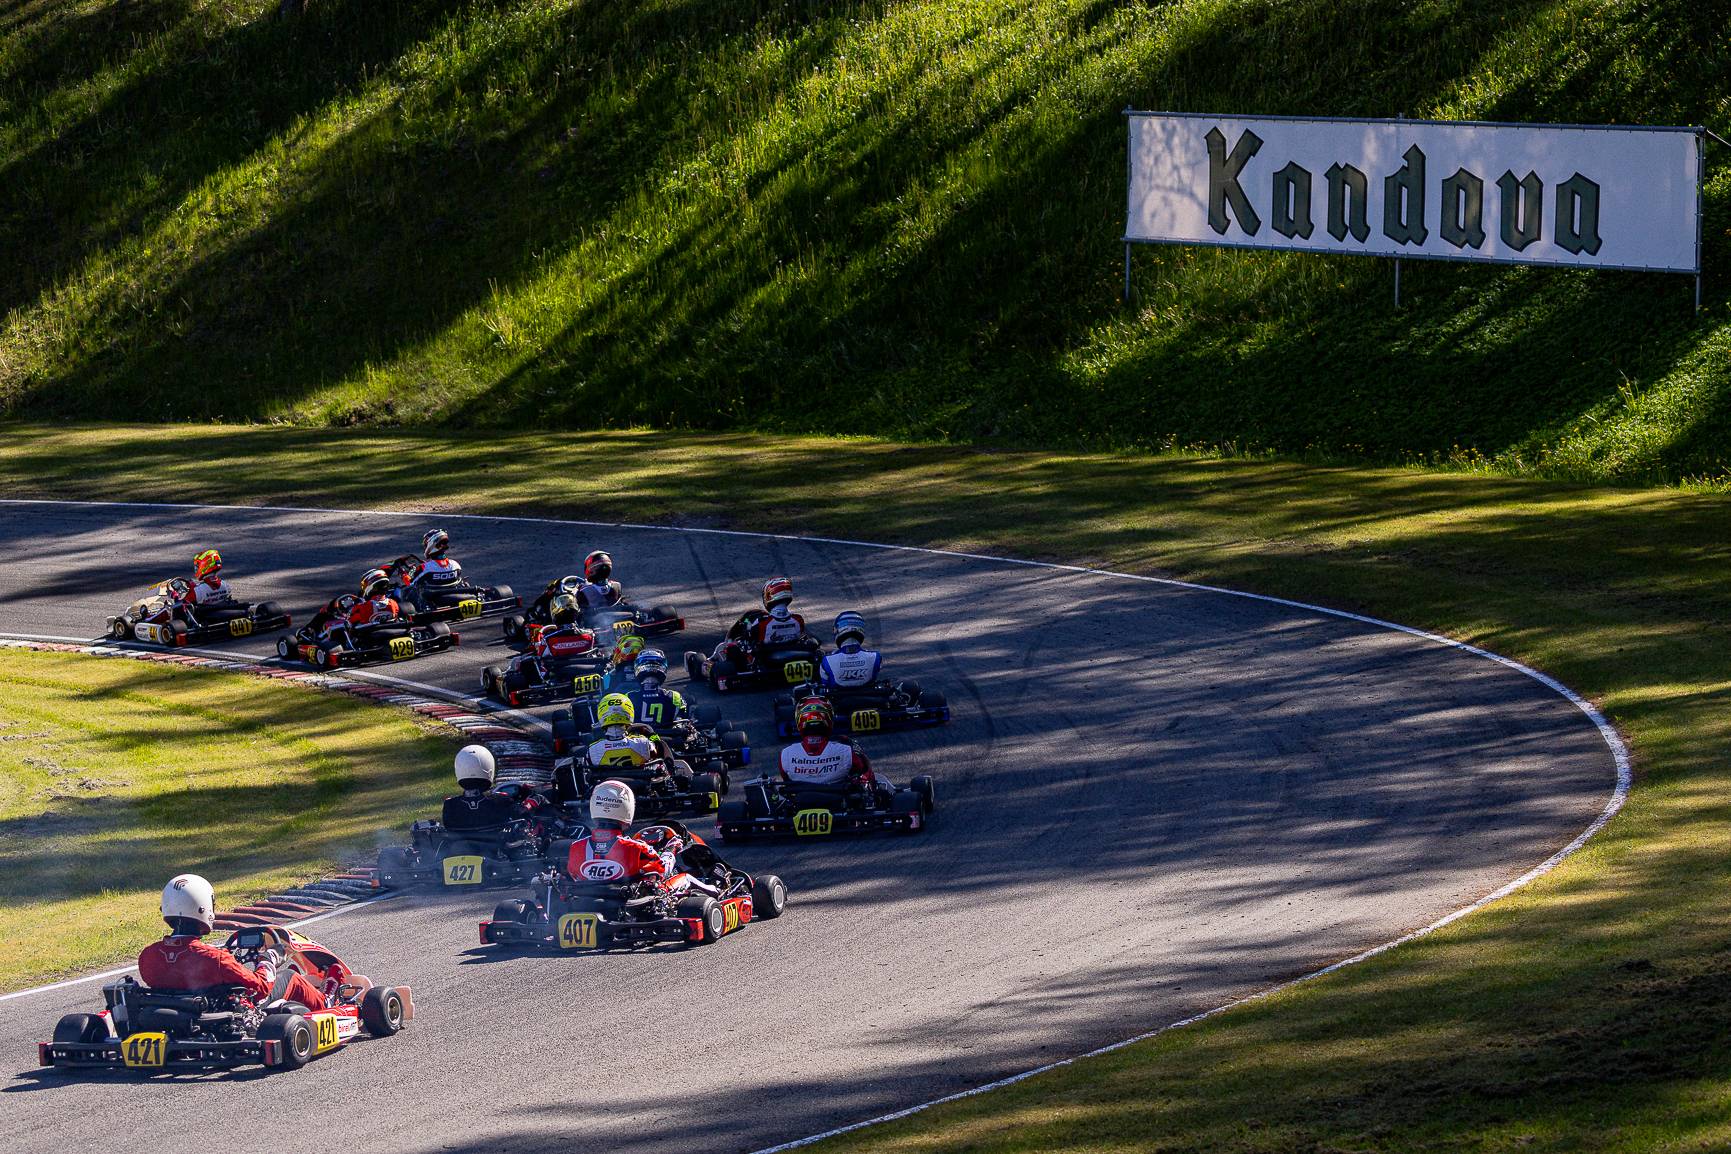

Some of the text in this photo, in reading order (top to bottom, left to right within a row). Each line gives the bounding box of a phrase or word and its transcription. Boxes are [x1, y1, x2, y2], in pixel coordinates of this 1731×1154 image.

[1203, 126, 1602, 257] Kandava
[392, 640, 414, 658] 429
[786, 664, 812, 680] 445
[575, 674, 600, 692] 456
[854, 711, 879, 730] 405
[791, 755, 841, 764] Kalnciems
[797, 812, 829, 832] 409
[449, 864, 475, 881] 427
[588, 864, 616, 877] AGS
[563, 919, 594, 945] 407
[319, 1016, 335, 1047] 421
[127, 1037, 161, 1065] 421
